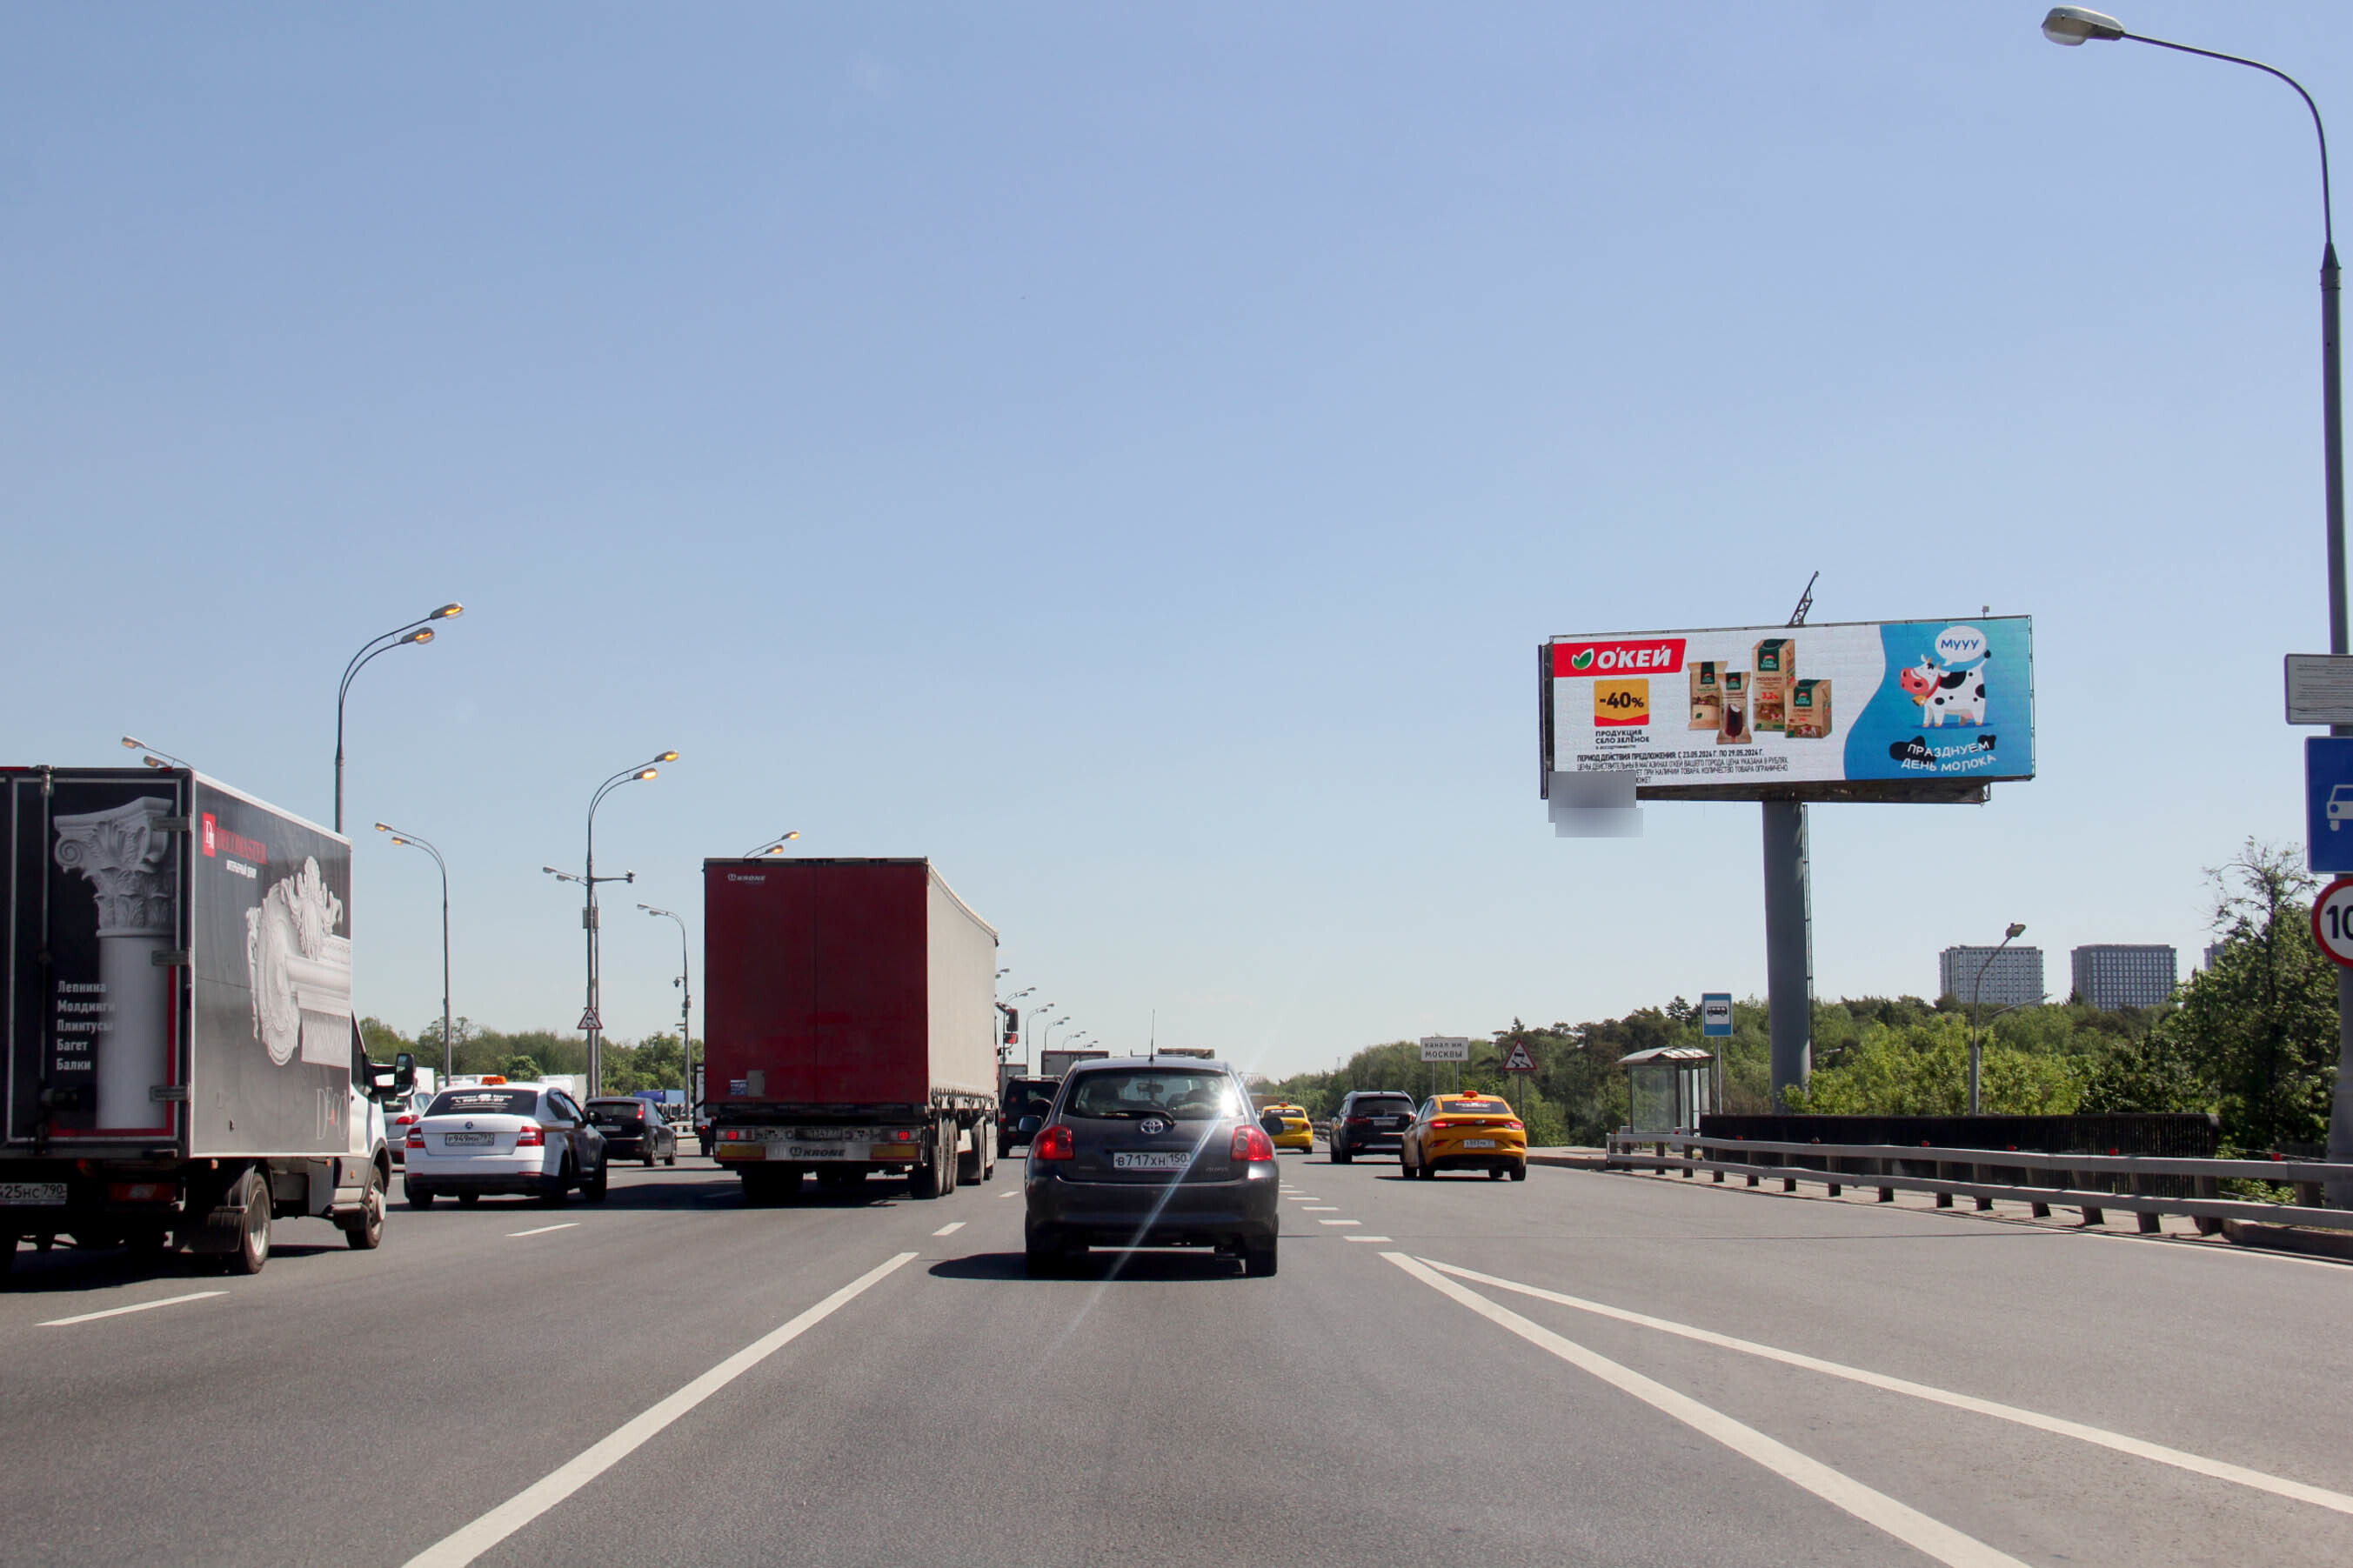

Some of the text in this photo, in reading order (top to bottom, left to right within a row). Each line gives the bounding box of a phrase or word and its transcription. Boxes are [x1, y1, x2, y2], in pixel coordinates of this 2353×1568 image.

[1600, 691, 1645, 709] -40%
[1595, 729, 1642, 737] ПРОДУКЦИЯ
[1908, 741, 1990, 758] ПРАЗДНУЕМ
[1601, 752, 1631, 762] ДЕЙСТВИЯ
[1901, 754, 1997, 772] ДЕНЬ МОЛОКА
[57, 981, 107, 993] Лепнина
[57, 1000, 116, 1014] Молдинги
[57, 1019, 114, 1035] Плинтусы
[57, 1038, 89, 1051] Багет
[57, 1058, 91, 1071] Балки
[1118, 1153, 1187, 1166] В717ХН 150
[42, 1184, 64, 1195] 790
